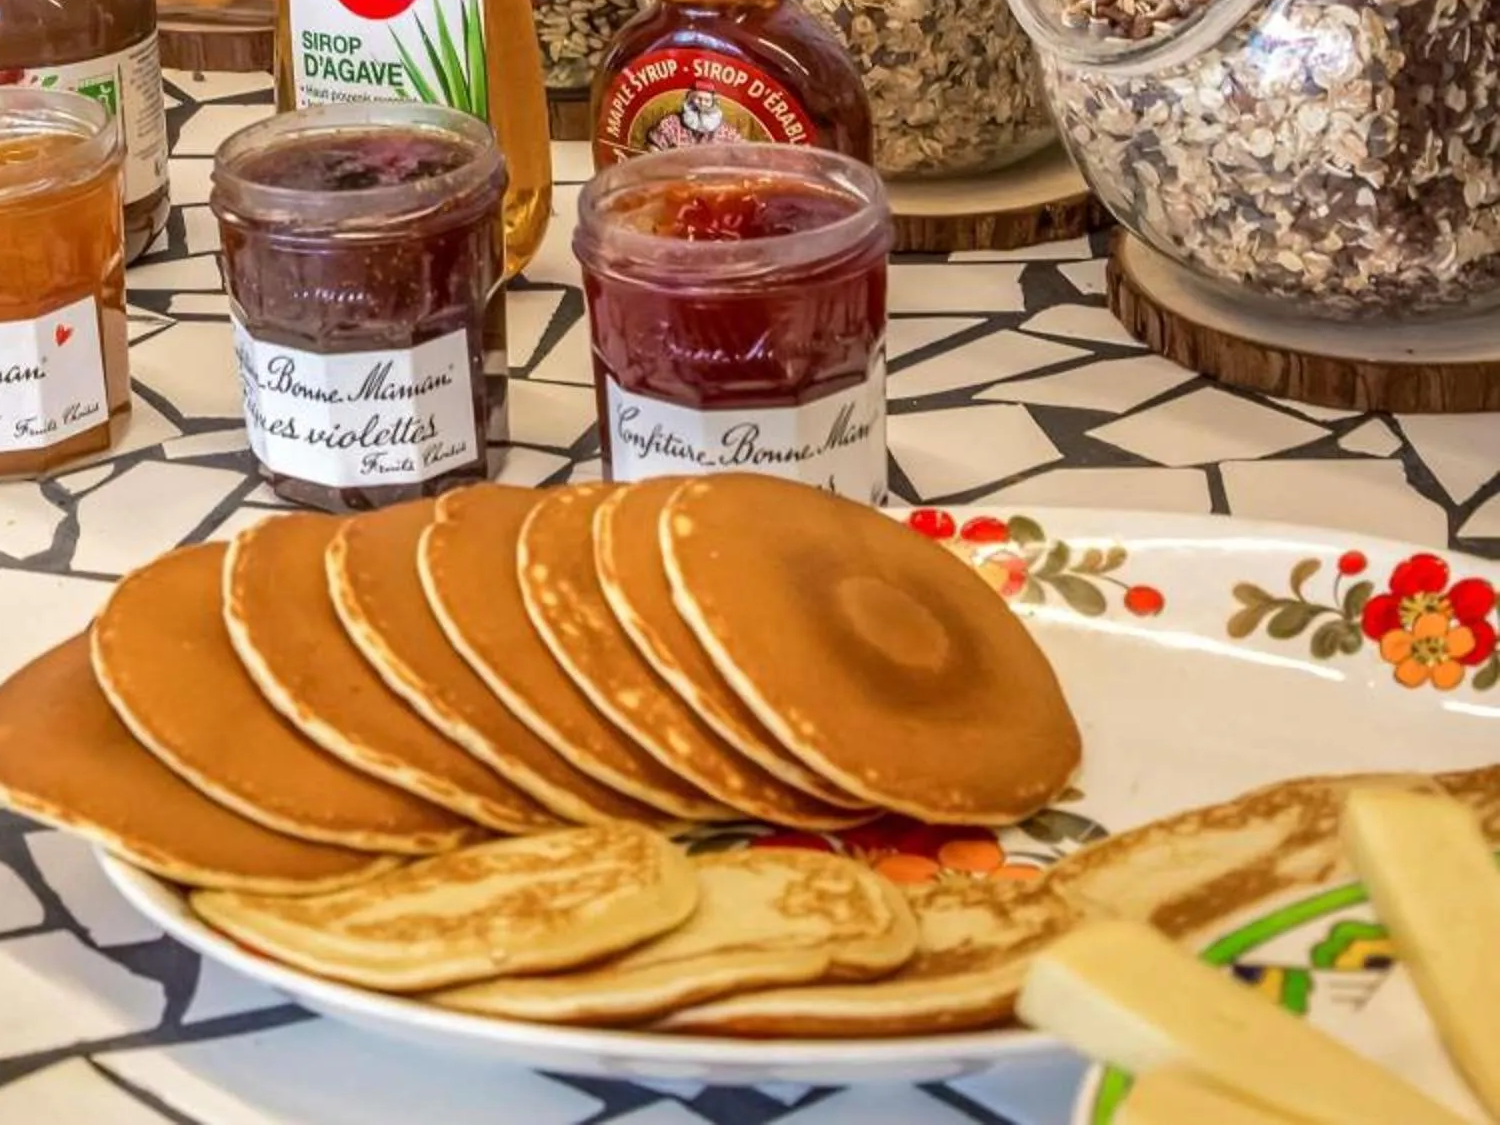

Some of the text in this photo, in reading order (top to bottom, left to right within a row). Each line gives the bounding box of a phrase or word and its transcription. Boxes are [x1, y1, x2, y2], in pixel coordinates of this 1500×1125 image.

[302, 30, 362, 55] SIROP
[303, 53, 404, 86] D'AGAVE
[606, 59, 811, 147] MAPLE SYRUP SIROP D'ÉRABL
[266, 355, 343, 403] Bonne
[348, 359, 452, 403] Maman
[14, 417, 57, 438] Fruits
[304, 414, 439, 449] violettes
[616, 400, 716, 465] Confiture
[721, 422, 814, 465] Bonne
[360, 451, 415, 475] Fruits
